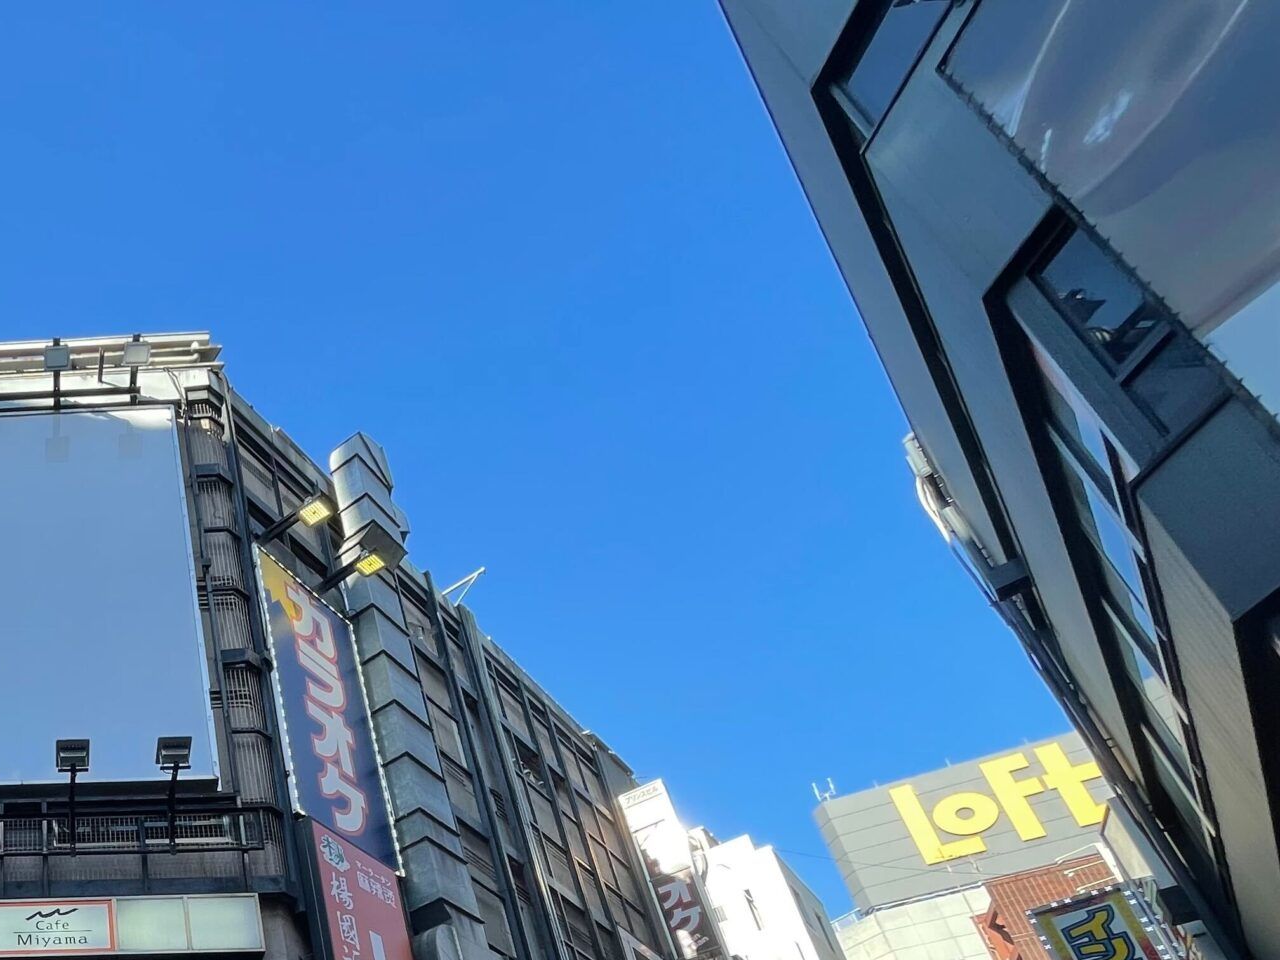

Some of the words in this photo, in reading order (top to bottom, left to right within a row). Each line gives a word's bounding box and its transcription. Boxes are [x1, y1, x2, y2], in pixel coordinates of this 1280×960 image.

[285, 582, 368, 835] カラオケ
[35, 919, 70, 931] Cafe
[16, 932, 89, 948] Miyama
